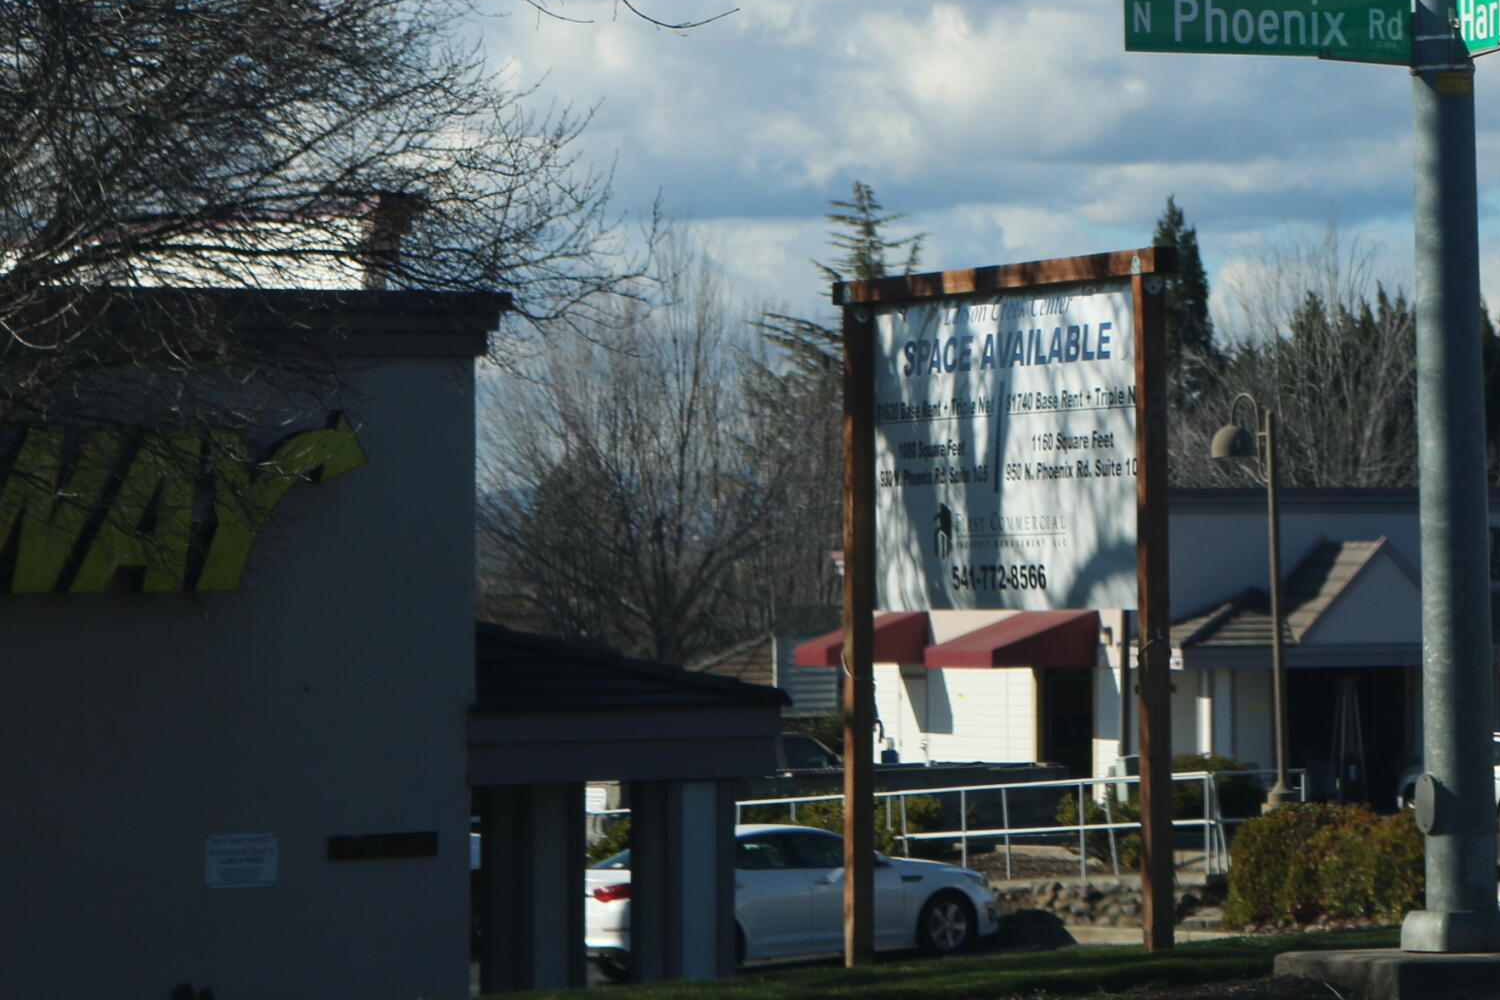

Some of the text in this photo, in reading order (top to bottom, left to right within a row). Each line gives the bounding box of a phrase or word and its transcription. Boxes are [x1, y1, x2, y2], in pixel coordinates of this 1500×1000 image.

[1132, 1, 1152, 34] N
[1368, 8, 1403, 40] Rd
[1031, 295, 1074, 318] Center
[904, 321, 1113, 378] SPACE AVAILABLE
[1036, 390, 1058, 410] Base
[1061, 389, 1083, 409] Rent
[1094, 386, 1125, 409] Triple
[1032, 430, 1115, 454] 1160 Square Feet
[1006, 462, 1022, 481] 950
[1036, 460, 1074, 479] Phoenix
[1095, 459, 1122, 477] Suite
[1126, 457, 1138, 476] 10
[951, 563, 1047, 591] 541-772-8566
